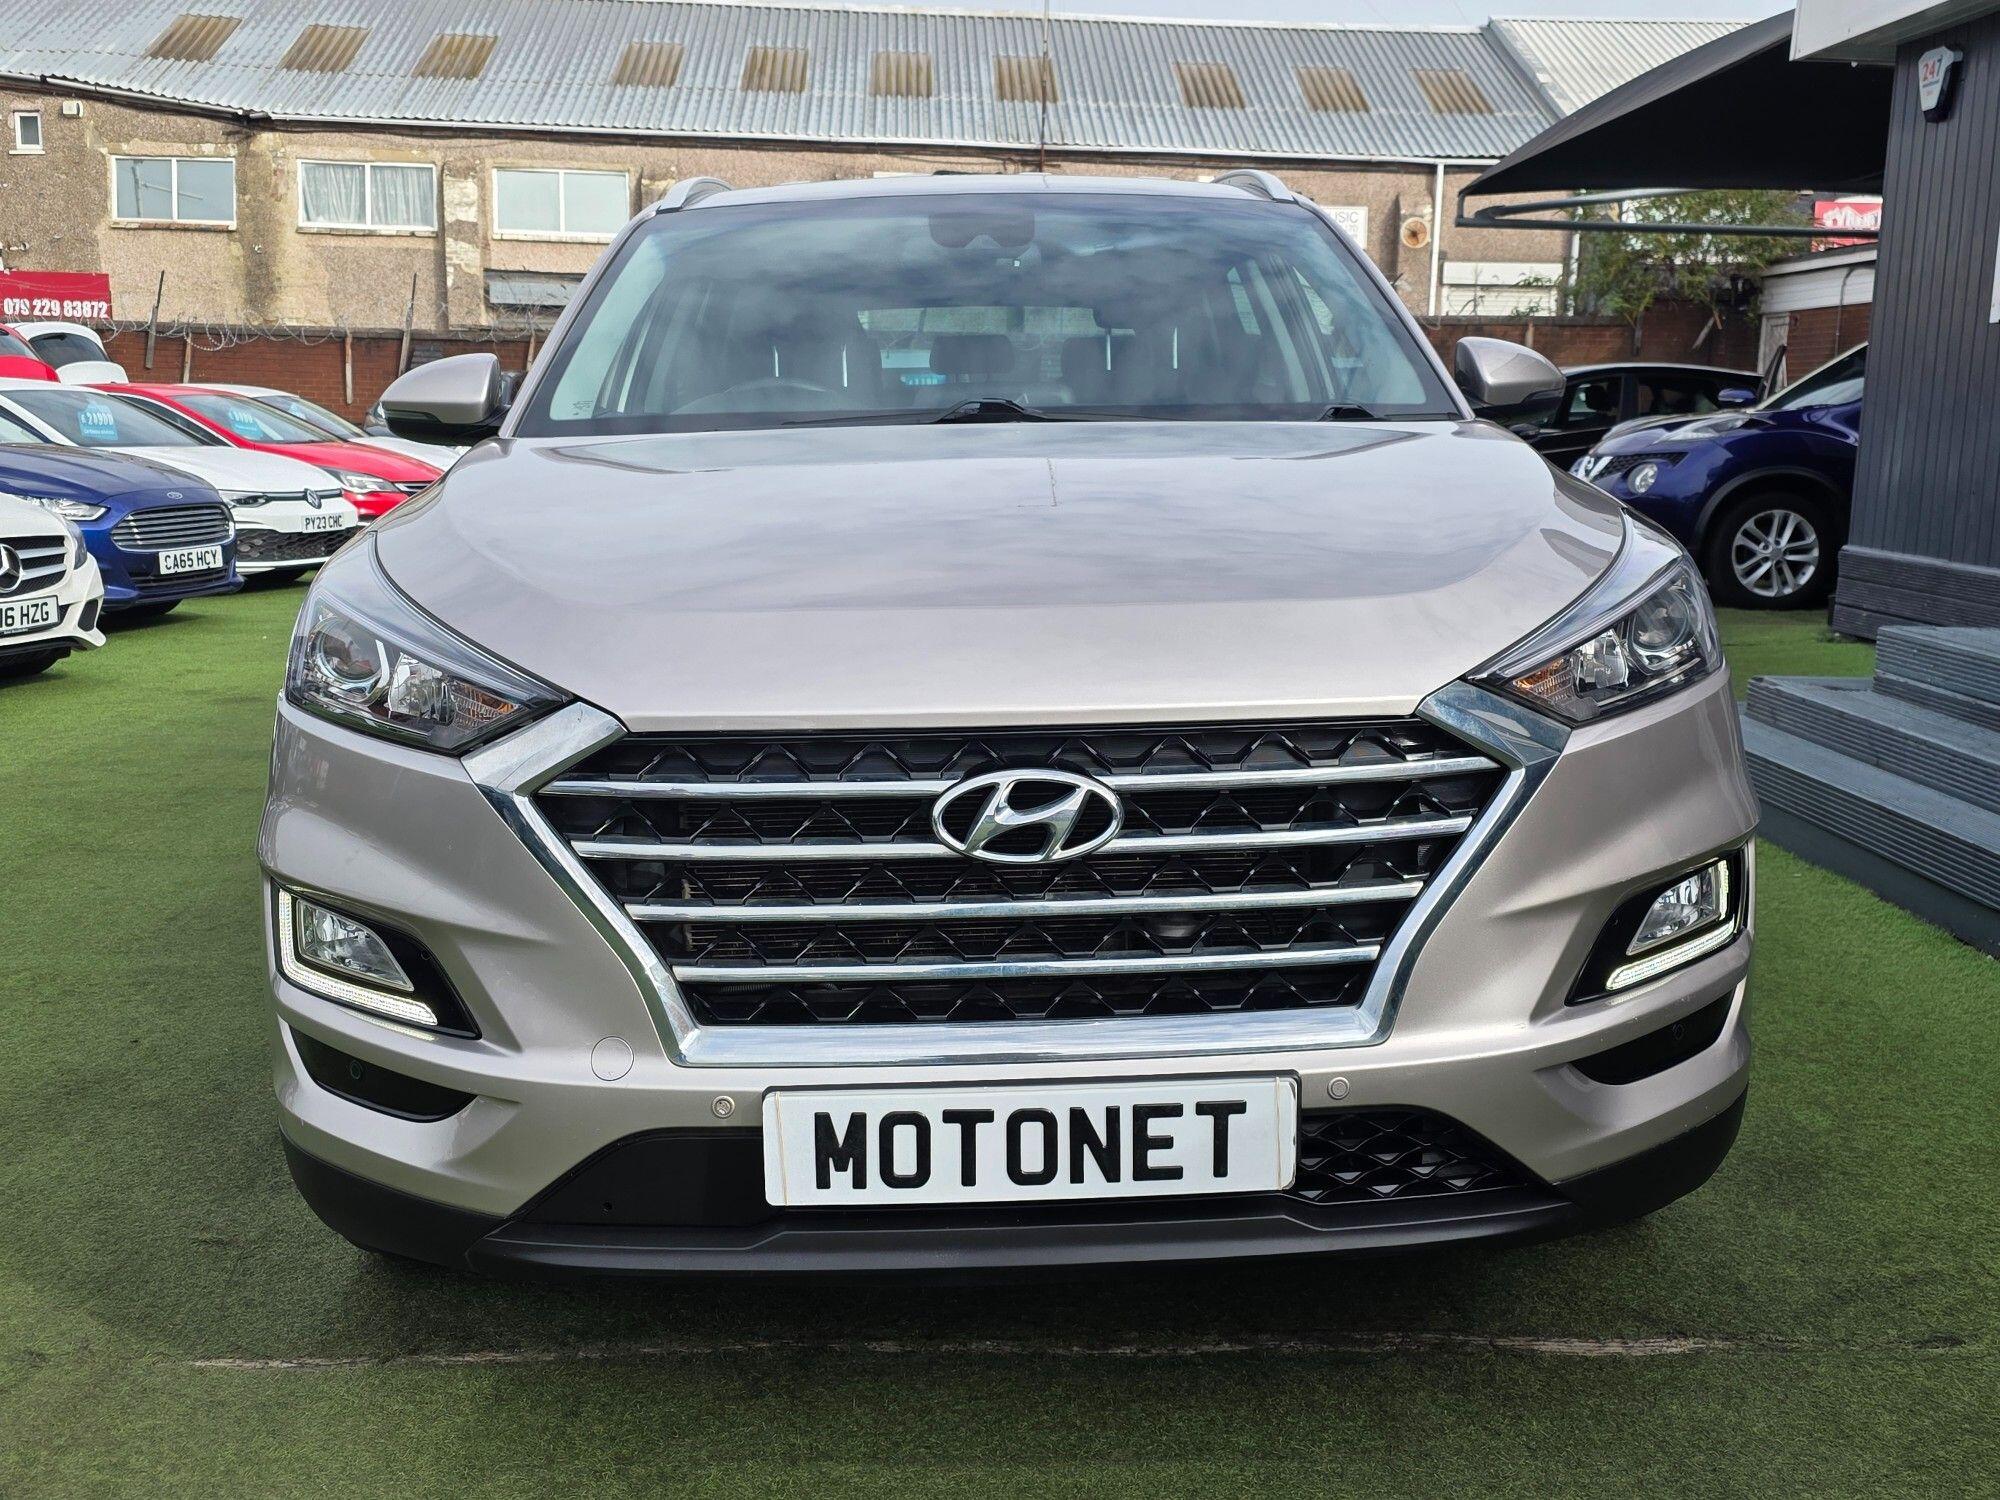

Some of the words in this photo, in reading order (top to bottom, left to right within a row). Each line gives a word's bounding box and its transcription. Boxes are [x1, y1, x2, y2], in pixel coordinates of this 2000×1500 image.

[32, 298, 60, 316] 229
[63, 299, 109, 318] 83872
[305, 516, 326, 530] PY23
[328, 515, 342, 528] CHC
[164, 552, 194, 570] CA65
[196, 550, 217, 567] HCY
[20, 601, 49, 625] HZG
[813, 1099, 1247, 1191] MOTONET
